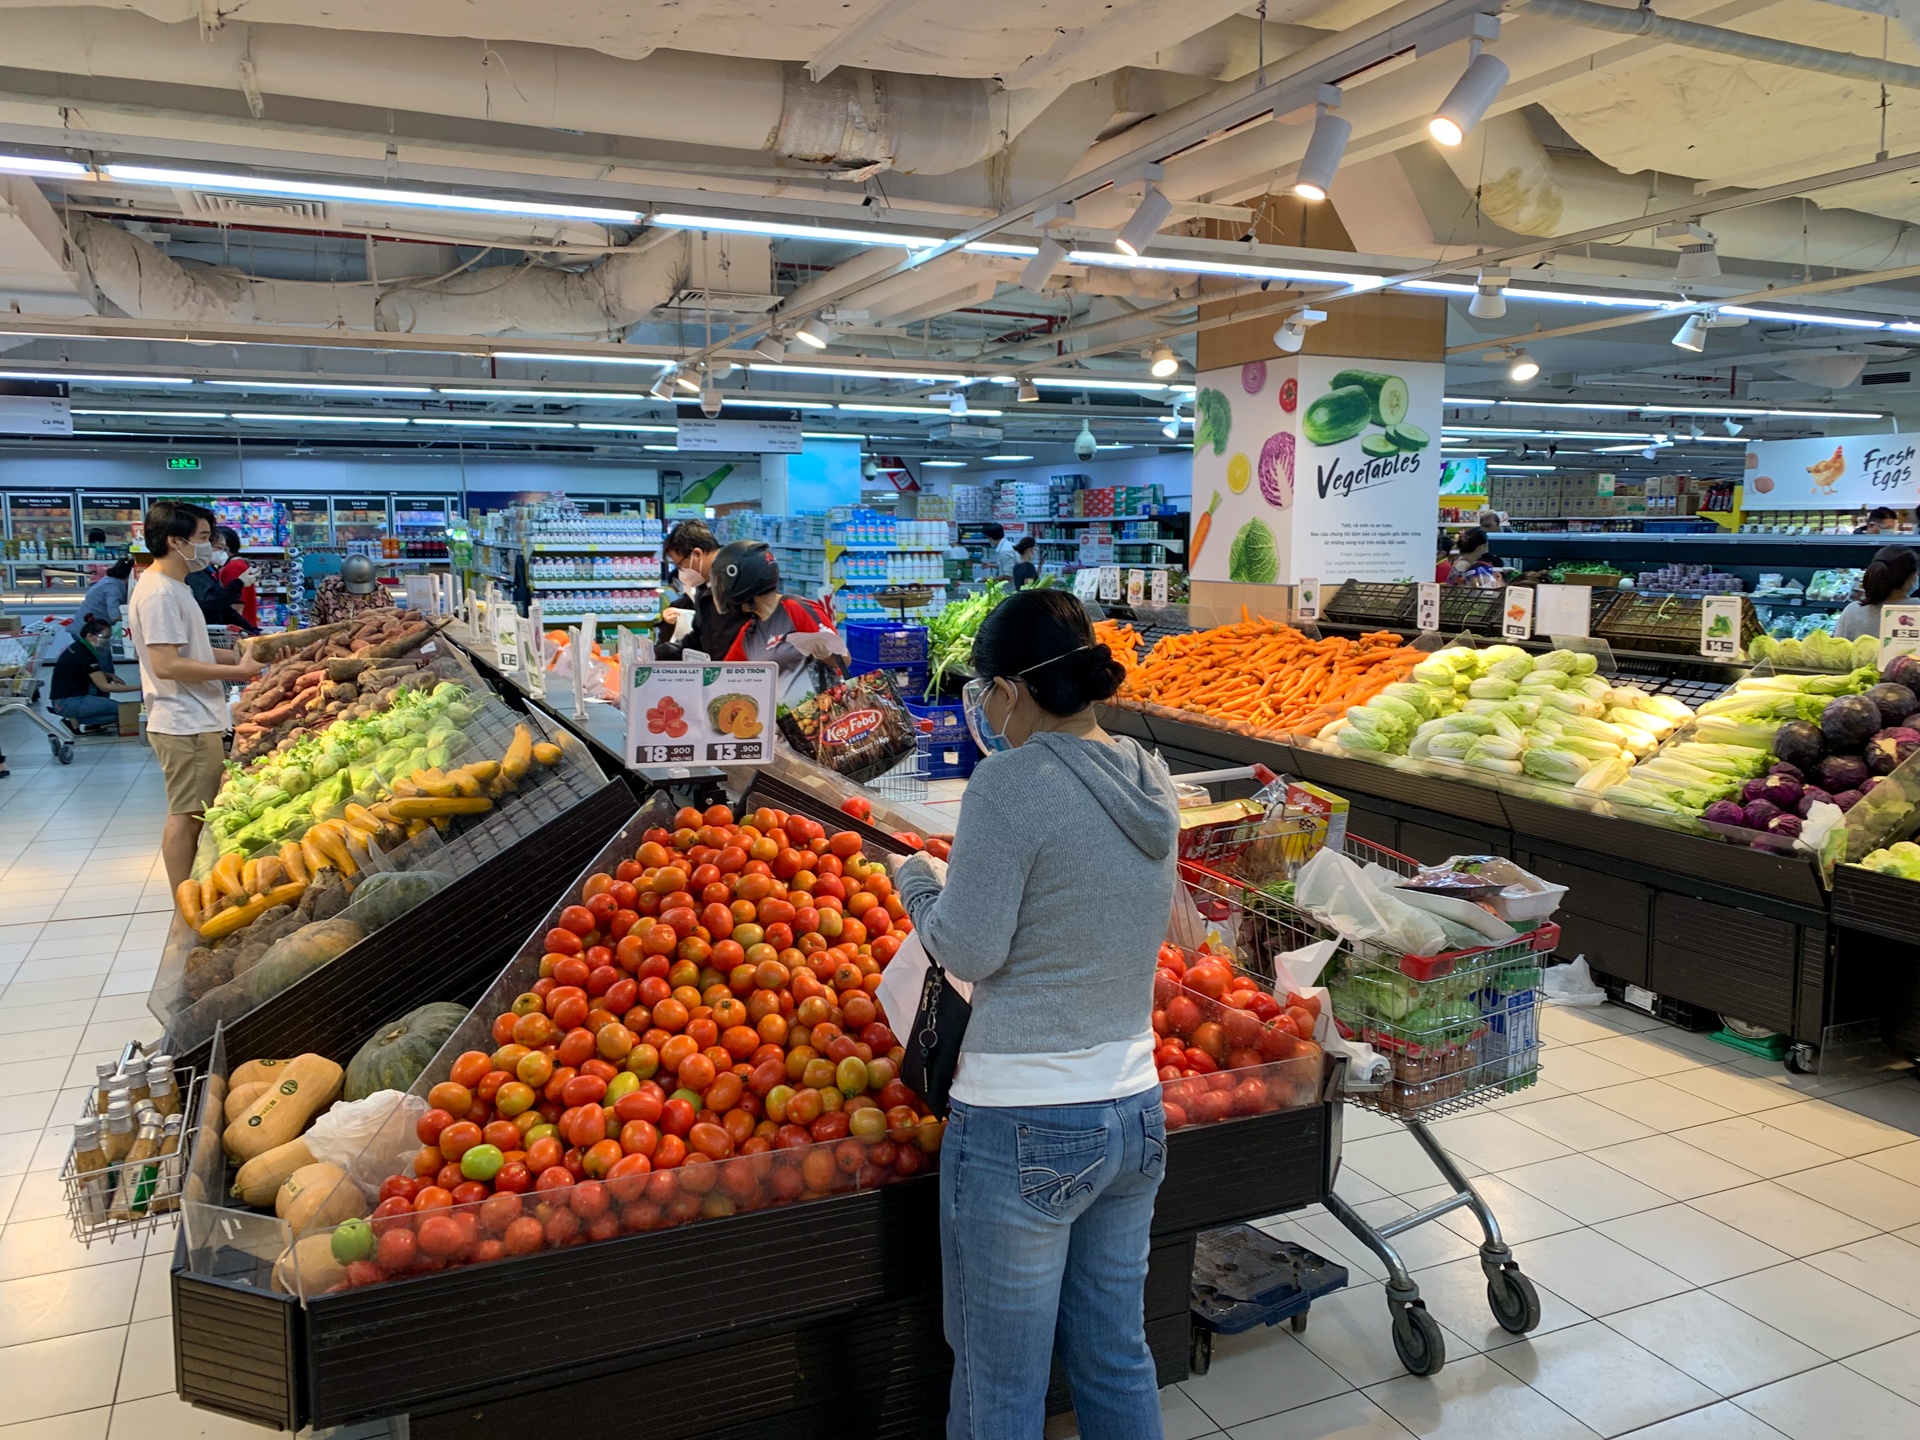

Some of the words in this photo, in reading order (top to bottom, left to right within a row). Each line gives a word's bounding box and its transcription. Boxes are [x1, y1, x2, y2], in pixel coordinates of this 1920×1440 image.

[56, 383, 64, 396] 1
[790, 410, 799, 421] 2
[1863, 446, 1916, 472] Fresh
[1317, 453, 1421, 499] Vegetables
[1872, 466, 1912, 491] Eggs
[1709, 641, 1722, 651] 14
[826, 724, 850, 742] Key
[849, 712, 876, 733] Food
[848, 731, 868, 744] FRESH
[644, 746, 668, 762] 18
[670, 747, 691, 755] .900
[714, 744, 737, 760] 13
[740, 745, 760, 753] .900
